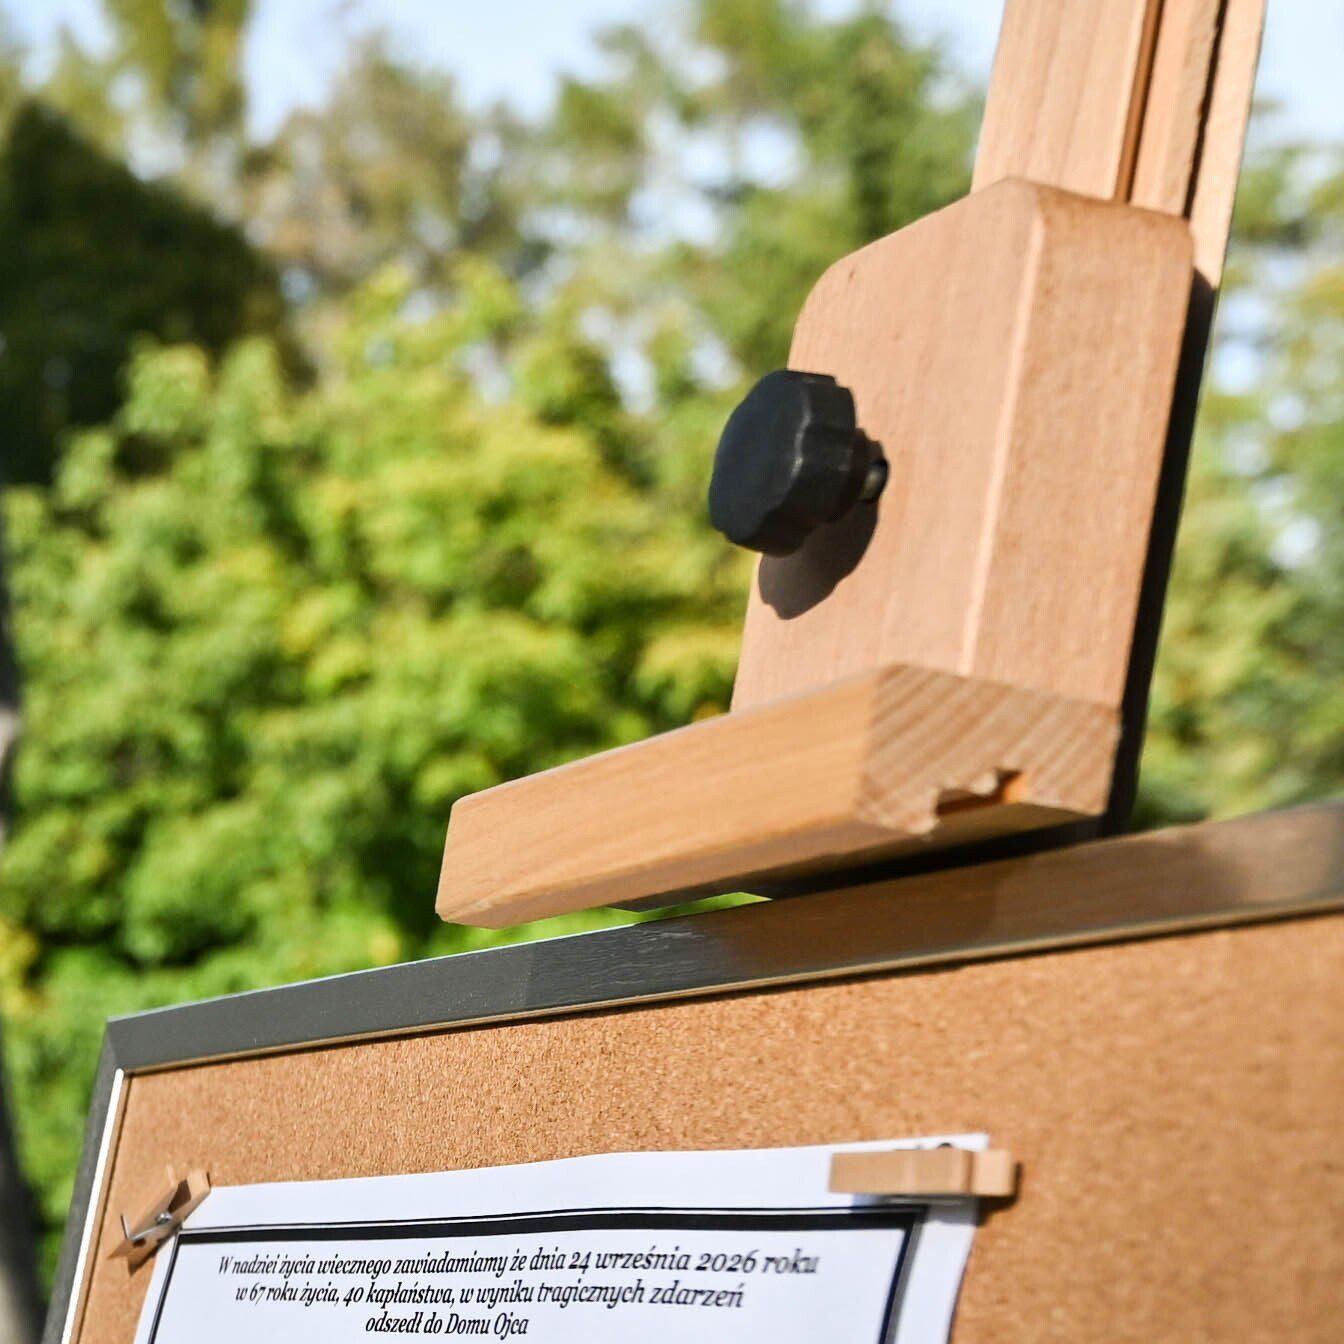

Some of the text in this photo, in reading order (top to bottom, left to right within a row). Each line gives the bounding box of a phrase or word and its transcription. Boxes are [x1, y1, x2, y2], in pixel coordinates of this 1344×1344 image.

[218, 1245, 820, 1281] W nadziei życia wiecznego zawiadamiamy że dnia 24 września 2026 roku
[235, 1277, 745, 1310] w 67 roku życia, 40 kapłaństwa, w wyniku tragicznych zdarzeń
[365, 1310, 530, 1342] odszedł do Domu Ojca
